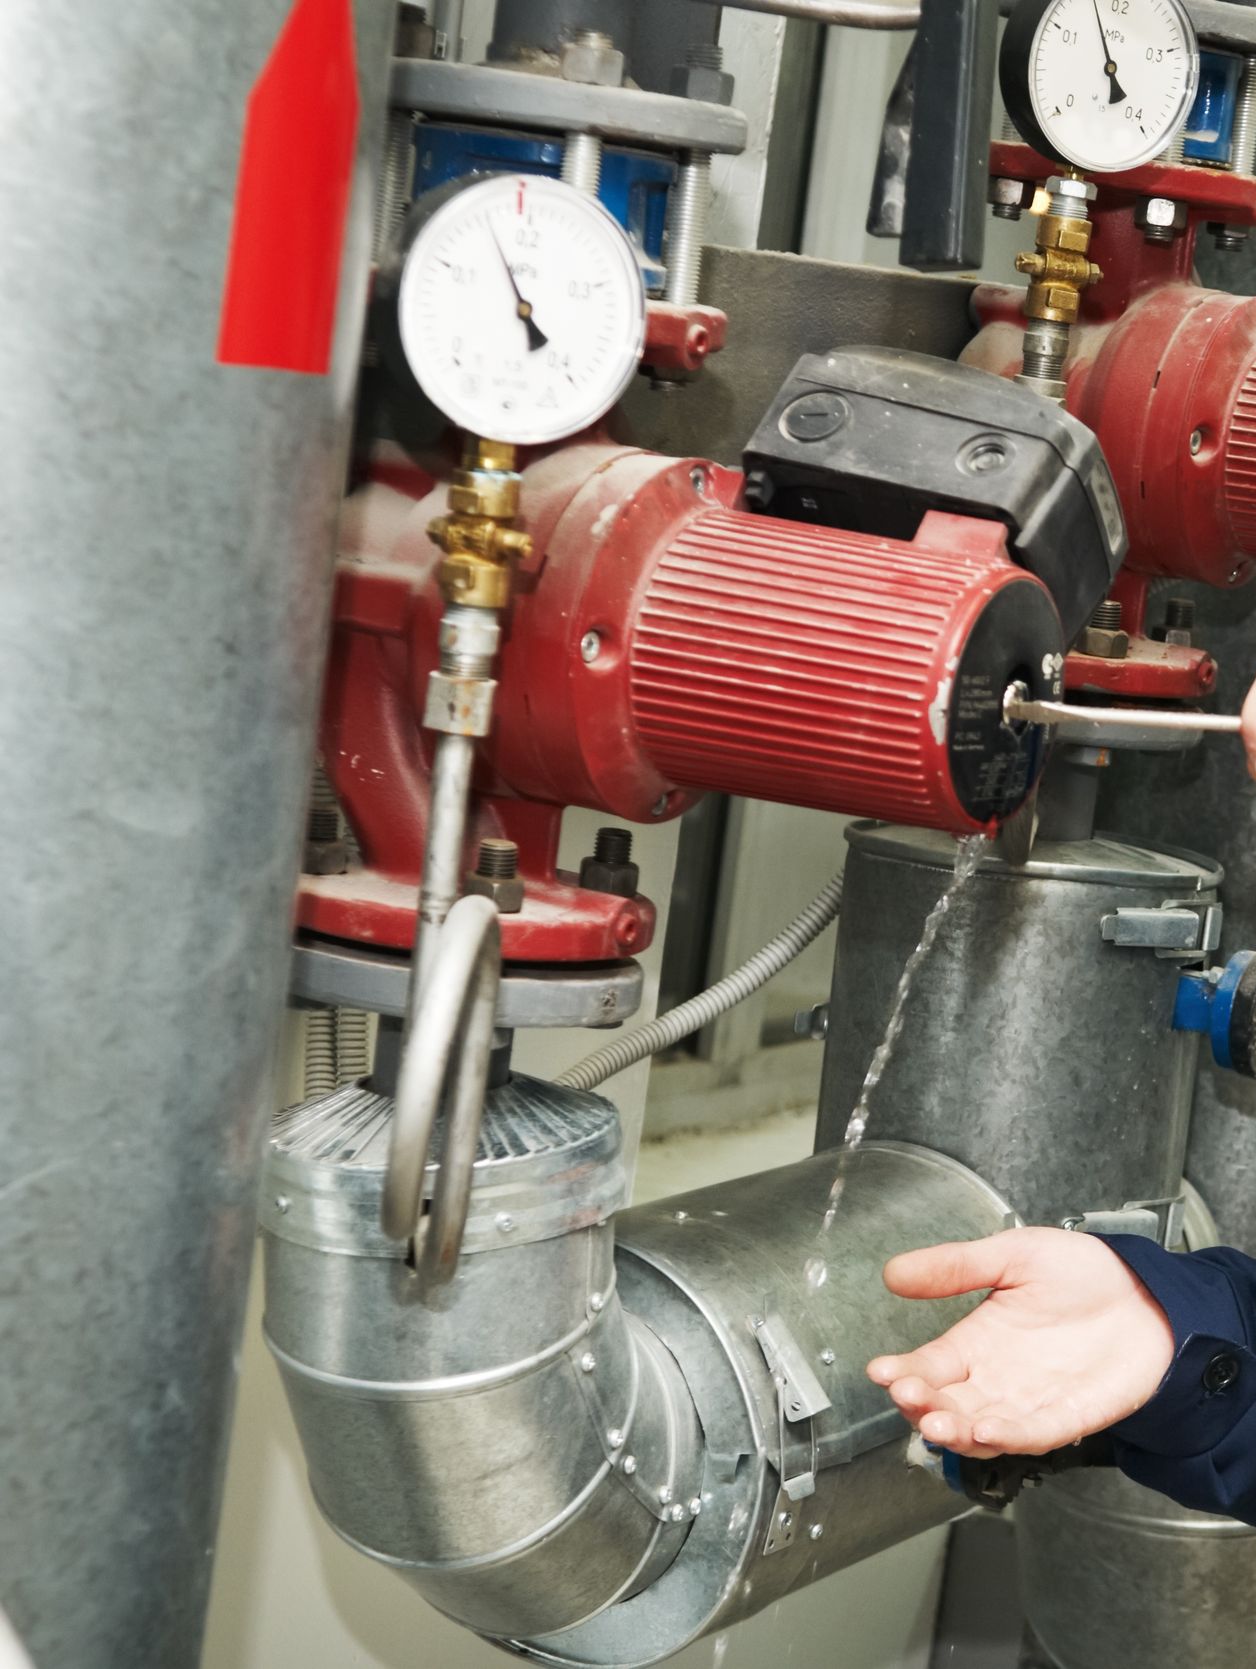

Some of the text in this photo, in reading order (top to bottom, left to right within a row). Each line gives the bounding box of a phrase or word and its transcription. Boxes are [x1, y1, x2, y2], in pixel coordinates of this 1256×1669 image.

[1111, 0, 1129, 15] 0,2
[1062, 29, 1078, 46] 0,1
[1104, 29, 1125, 43] MPa
[1145, 47, 1163, 63] 0,3
[1066, 94, 1074, 108] 0
[1125, 106, 1143, 121] 0,4
[515, 228, 540, 248] 0,2
[568, 281, 590, 299] 0,3
[453, 337, 463, 352] 0
